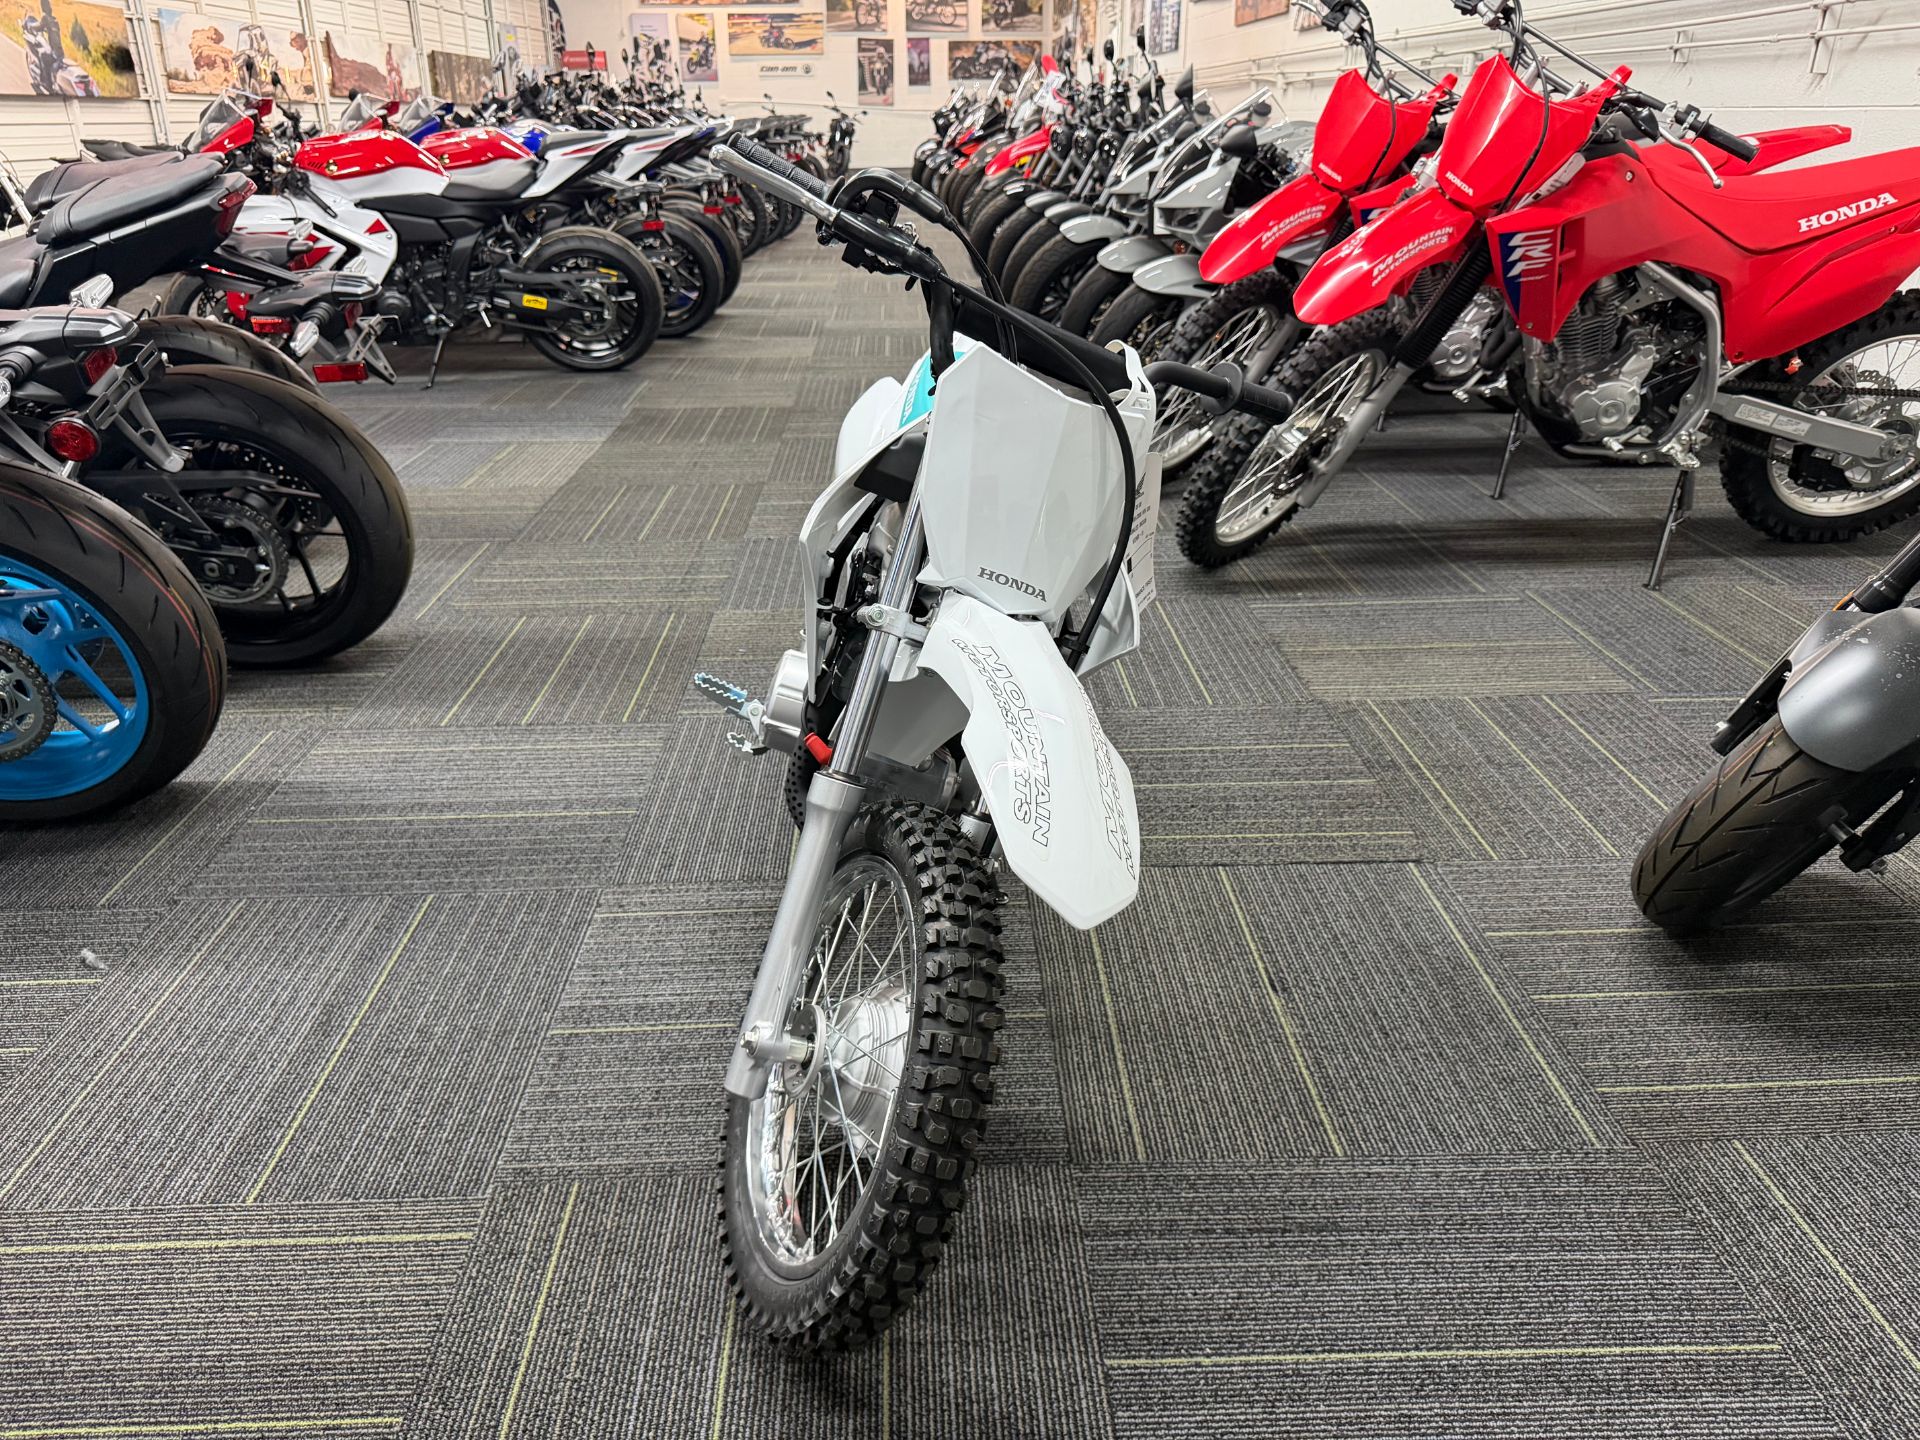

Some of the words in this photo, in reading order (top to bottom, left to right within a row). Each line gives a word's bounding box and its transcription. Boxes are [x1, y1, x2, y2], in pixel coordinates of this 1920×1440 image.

[1445, 171, 1474, 197] HONDA
[1797, 192, 1899, 233] HONDA
[1370, 234, 1450, 288] MOTORSPORTS
[1372, 226, 1454, 278] MOUNTAIN
[1506, 228, 1556, 278] CRF
[977, 566, 1047, 603] HONDA
[951, 638, 1032, 825] MOTORSPORTS
[972, 644, 1051, 848] MOUNTAIN
